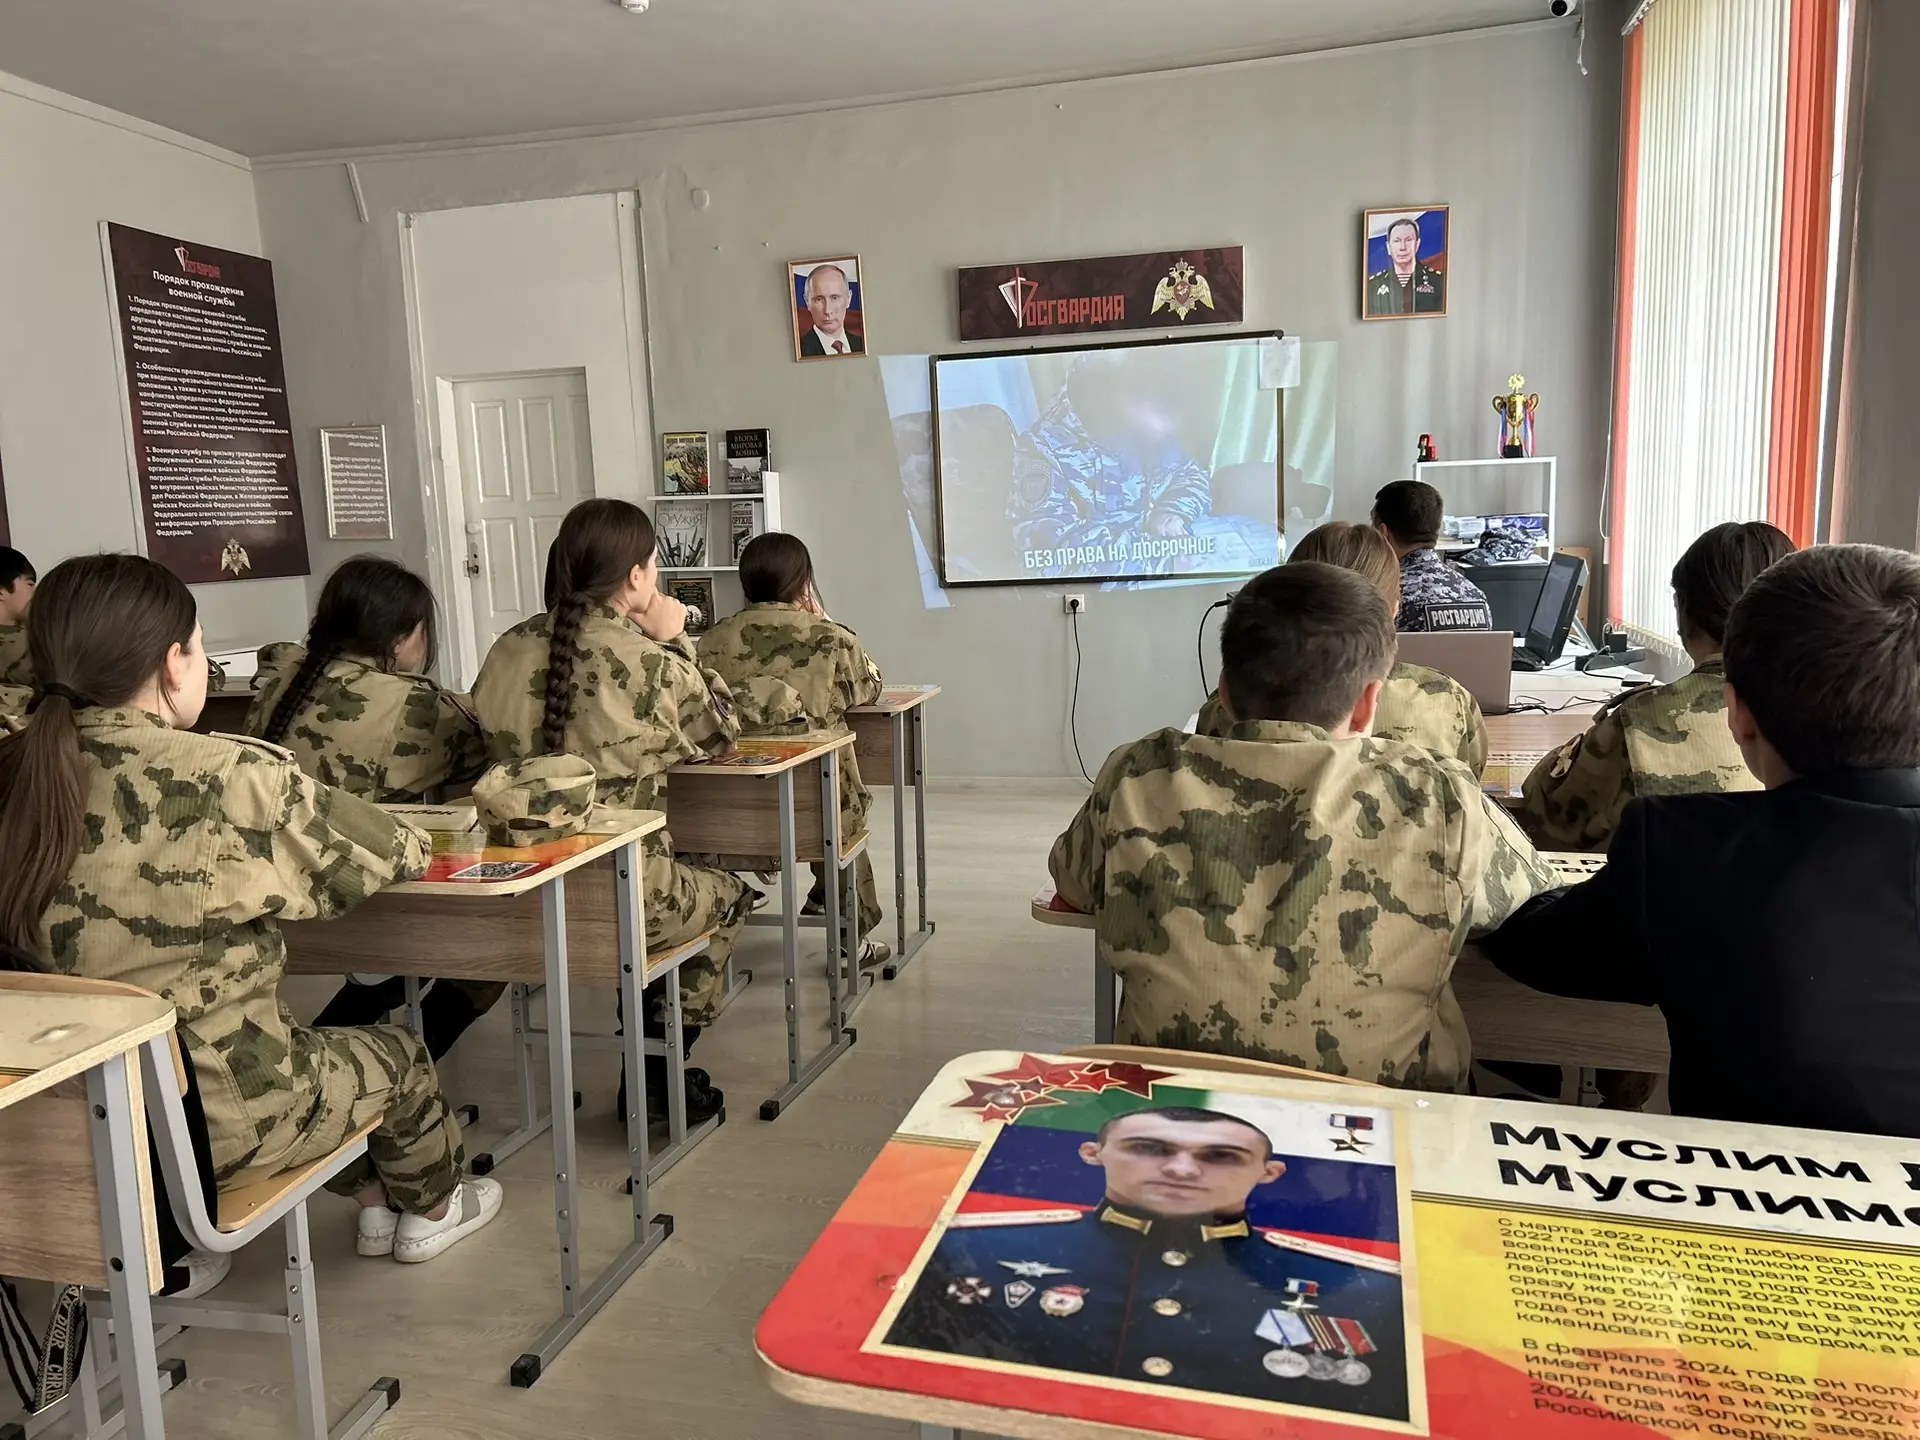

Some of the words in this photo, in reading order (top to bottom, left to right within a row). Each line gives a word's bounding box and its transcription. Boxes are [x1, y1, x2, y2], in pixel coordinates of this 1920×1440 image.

[153, 270, 189, 286] Порядок
[191, 280, 244, 296] прохождения
[169, 288, 203, 301] военной
[205, 295, 235, 307] службы
[134, 296, 160, 306] Порядок
[202, 310, 225, 318] военной
[226, 314, 246, 322] службы
[142, 362, 180, 373] Особенности
[167, 430, 200, 438] Российской
[1024, 550, 1053, 569] БЕЗ
[1056, 546, 1104, 566] ПРАВА
[1109, 543, 1128, 561] НА
[1132, 536, 1215, 560] ДОСРОЧНОЕ
[1431, 609, 1486, 627] РОСГВАРДИЯ
[1490, 1122, 1872, 1183] Муслим
[1498, 1216, 1512, 1228] С
[1520, 1220, 1583, 1236] марта
[1592, 1227, 1645, 1244] 2022
[1652, 1235, 1702, 1250] года
[1709, 1242, 1736, 1254] он
[1745, 1246, 1903, 1274] добровольно
[1500, 1227, 1552, 1243] 2022
[1561, 1235, 1609, 1250] года
[1617, 1241, 1664, 1256] был
[1671, 1248, 1809, 1273] участником
[1816, 1264, 1872, 1281] СВО.
[1503, 1238, 1598, 1259] военной
[1605, 1250, 1676, 1268] части.
[1698, 1261, 1808, 1284] февраля
[1814, 1275, 1875, 1291] 2023
[1505, 1250, 1634, 1275] досрочные
[1642, 1266, 1715, 1284] курсы
[1723, 1276, 1752, 1288] по
[1760, 1280, 1899, 1305] подготовке
[1510, 1273, 1574, 1292] сразу
[1583, 1282, 1615, 1295] же
[1623, 1286, 1672, 1302] был
[1681, 1294, 1818, 1319] направлен
[1826, 1311, 1841, 1322] в
[1848, 1313, 1905, 1332] зону
[1512, 1286, 1606, 1308] октябре
[1613, 1298, 1672, 1315] 2023
[1681, 1307, 1735, 1323] года
[1744, 1314, 1789, 1331] ему
[1797, 1321, 1910, 1344] вручили
[1687, 1284, 1731, 1298] мая
[1738, 1289, 1799, 1306] 2023
[1807, 1298, 1862, 1314] года
[52, 1315, 66, 1349] DIOR
[1515, 1298, 1568, 1314] года
[1575, 1306, 1604, 1319] он
[1613, 1311, 1748, 1338] руководил
[1881, 1344, 1896, 1356] а
[1516, 1311, 1671, 1340] командовал
[1678, 1331, 1758, 1351] ротой.
[1522, 1340, 1538, 1352] В
[1546, 1343, 1666, 1368] феврале
[1674, 1359, 1737, 1376] 2024
[1746, 1368, 1805, 1385] года
[1814, 1376, 1846, 1390] он
[1525, 1354, 1600, 1373] имеет
[1610, 1365, 1710, 1388] медаль
[1528, 1369, 1709, 1402] направлении
[1719, 1394, 1735, 1406] в
[1743, 1398, 1825, 1418] марте
[1832, 1409, 1904, 1429] 2024
[1530, 1384, 1594, 1402] 2024
[1603, 1394, 1665, 1412] года
[1534, 1400, 1701, 1432] Российской
